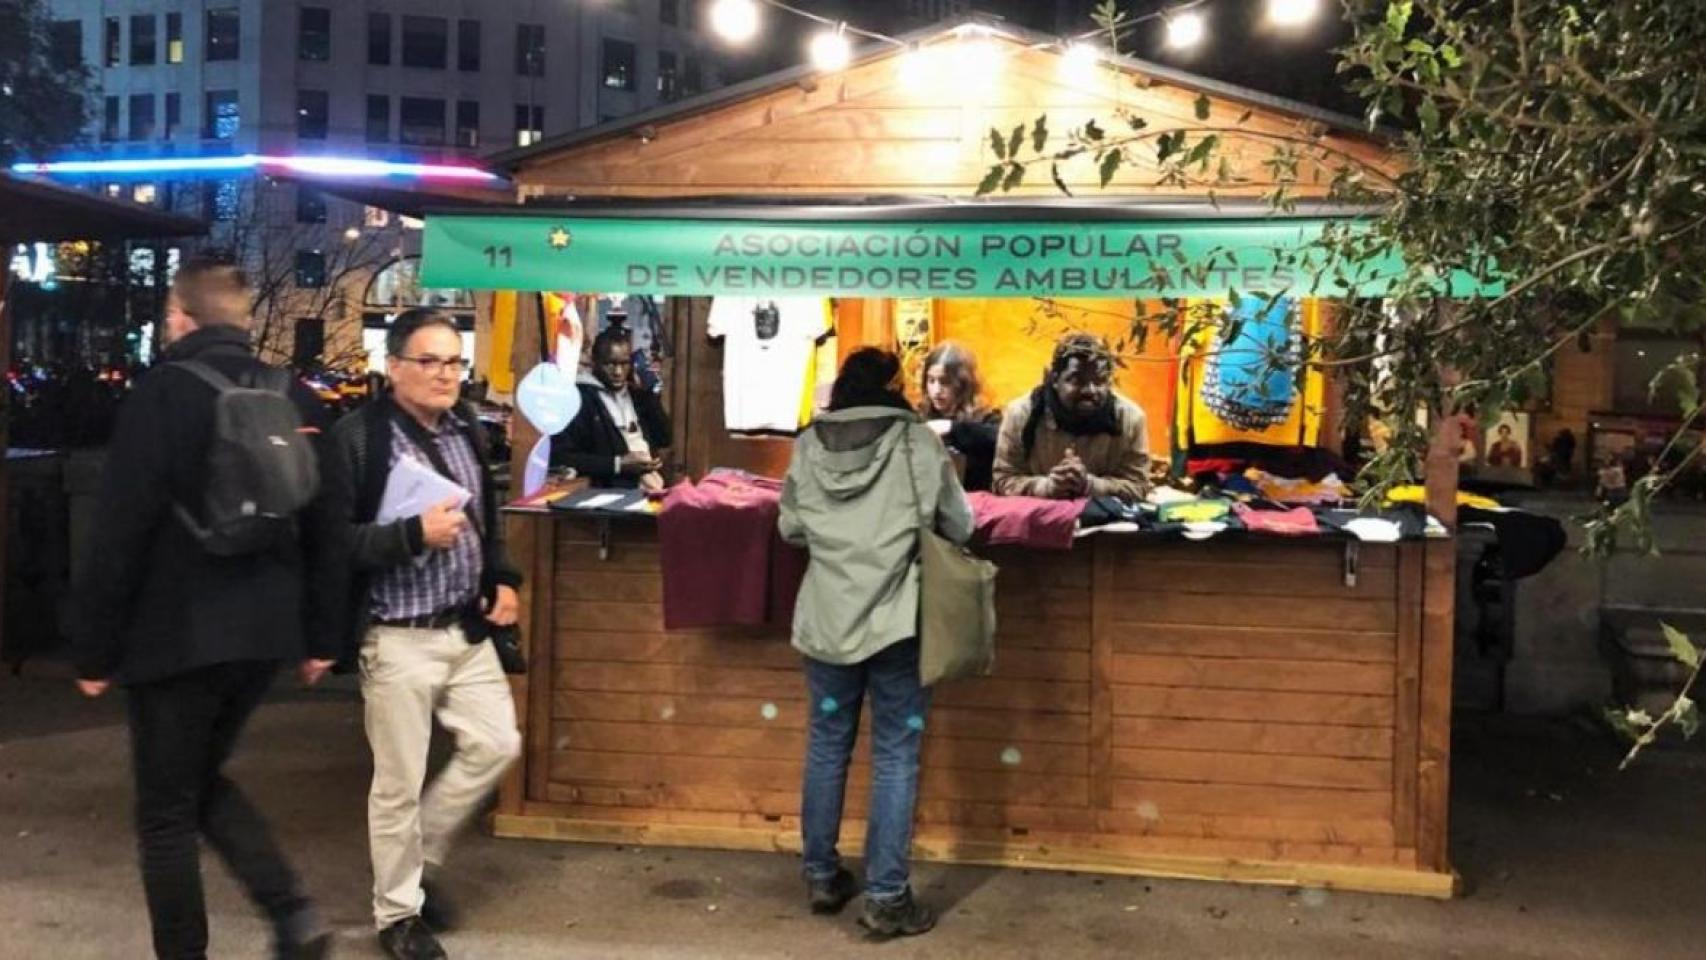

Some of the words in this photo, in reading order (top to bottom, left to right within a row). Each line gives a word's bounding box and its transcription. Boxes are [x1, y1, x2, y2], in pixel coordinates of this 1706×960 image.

[714, 228, 961, 258] ASOCIACIÓN
[981, 233, 1183, 258] POPULAR
[483, 245, 513, 268] 11
[626, 264, 679, 287] DE
[695, 265, 977, 290] VENDEDORES
[995, 267, 1297, 290] AMBULANTES
